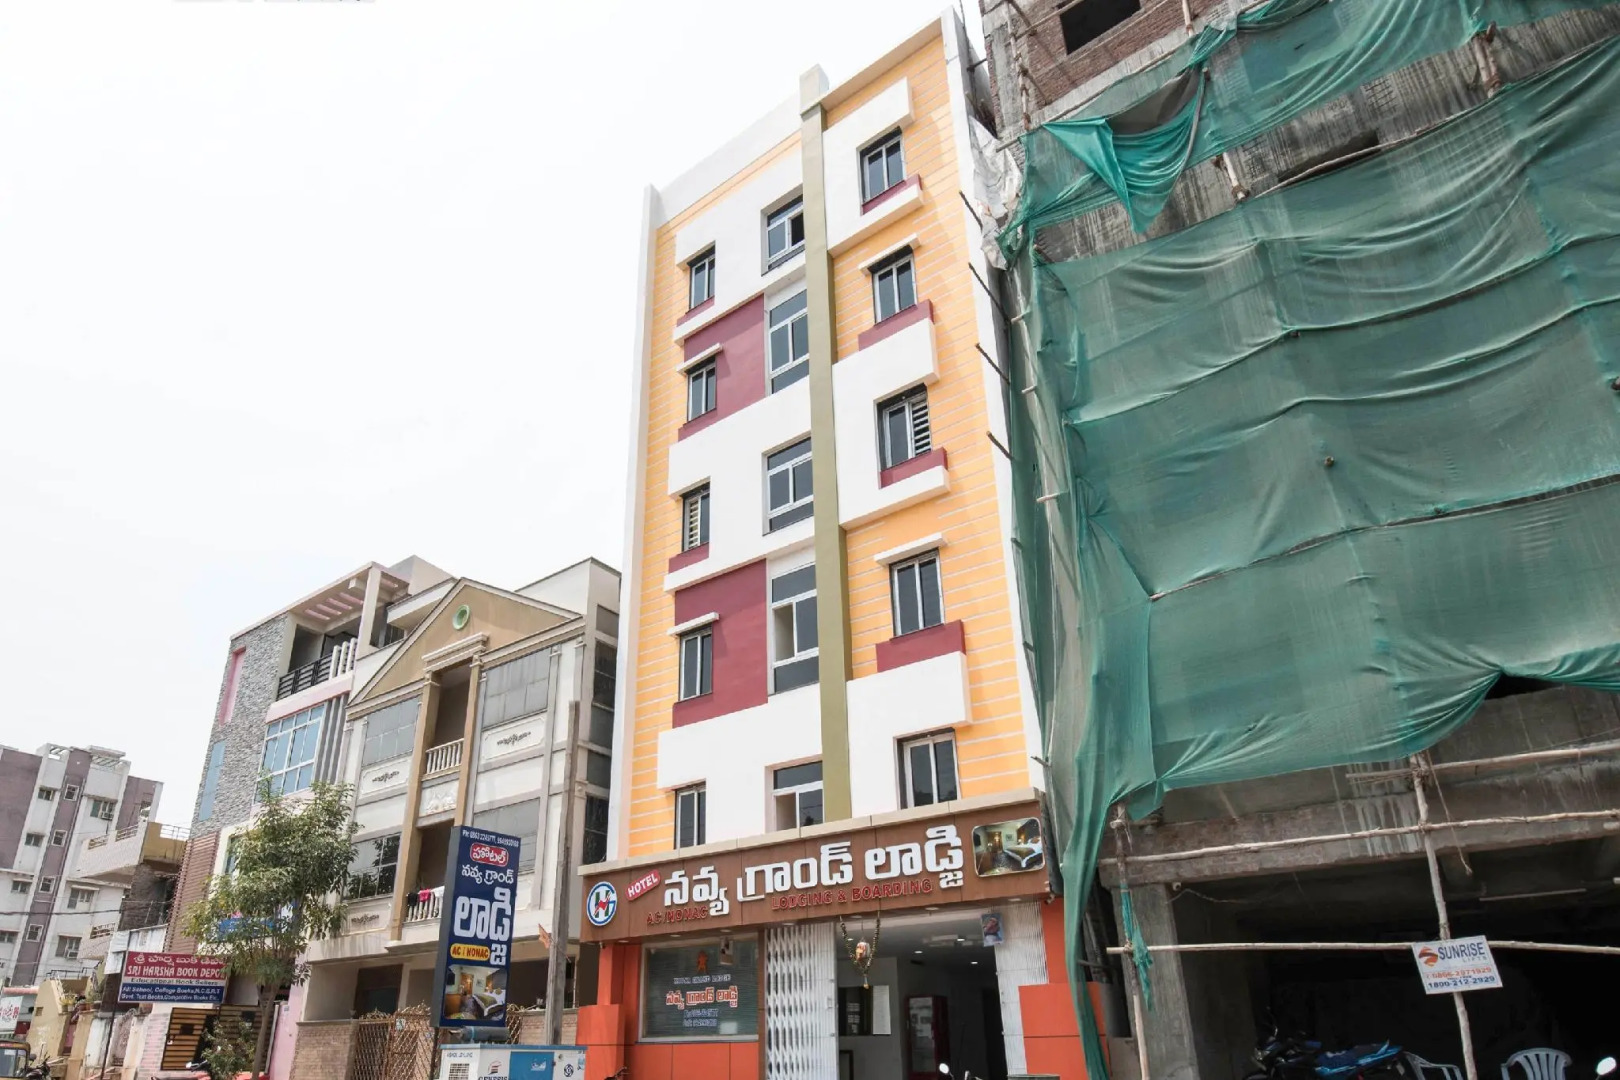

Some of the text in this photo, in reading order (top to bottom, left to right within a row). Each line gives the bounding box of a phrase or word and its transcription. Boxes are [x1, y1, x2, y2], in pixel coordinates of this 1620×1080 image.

[472, 846, 506, 864] హోటల్
[461, 864, 514, 885] నవ్య గ్రాండ్
[664, 824, 964, 916] నవ్య గ్రాండ్ లాడ్జి
[627, 872, 659, 898] HOTEL
[772, 878, 933, 910] LODGING & BOARDING
[452, 946, 461, 955] AC
[1438, 942, 1485, 960] SUNRISE
[127, 965, 141, 976] SRI
[142, 966, 175, 977] HARSHA
[176, 967, 198, 977] BOOK
